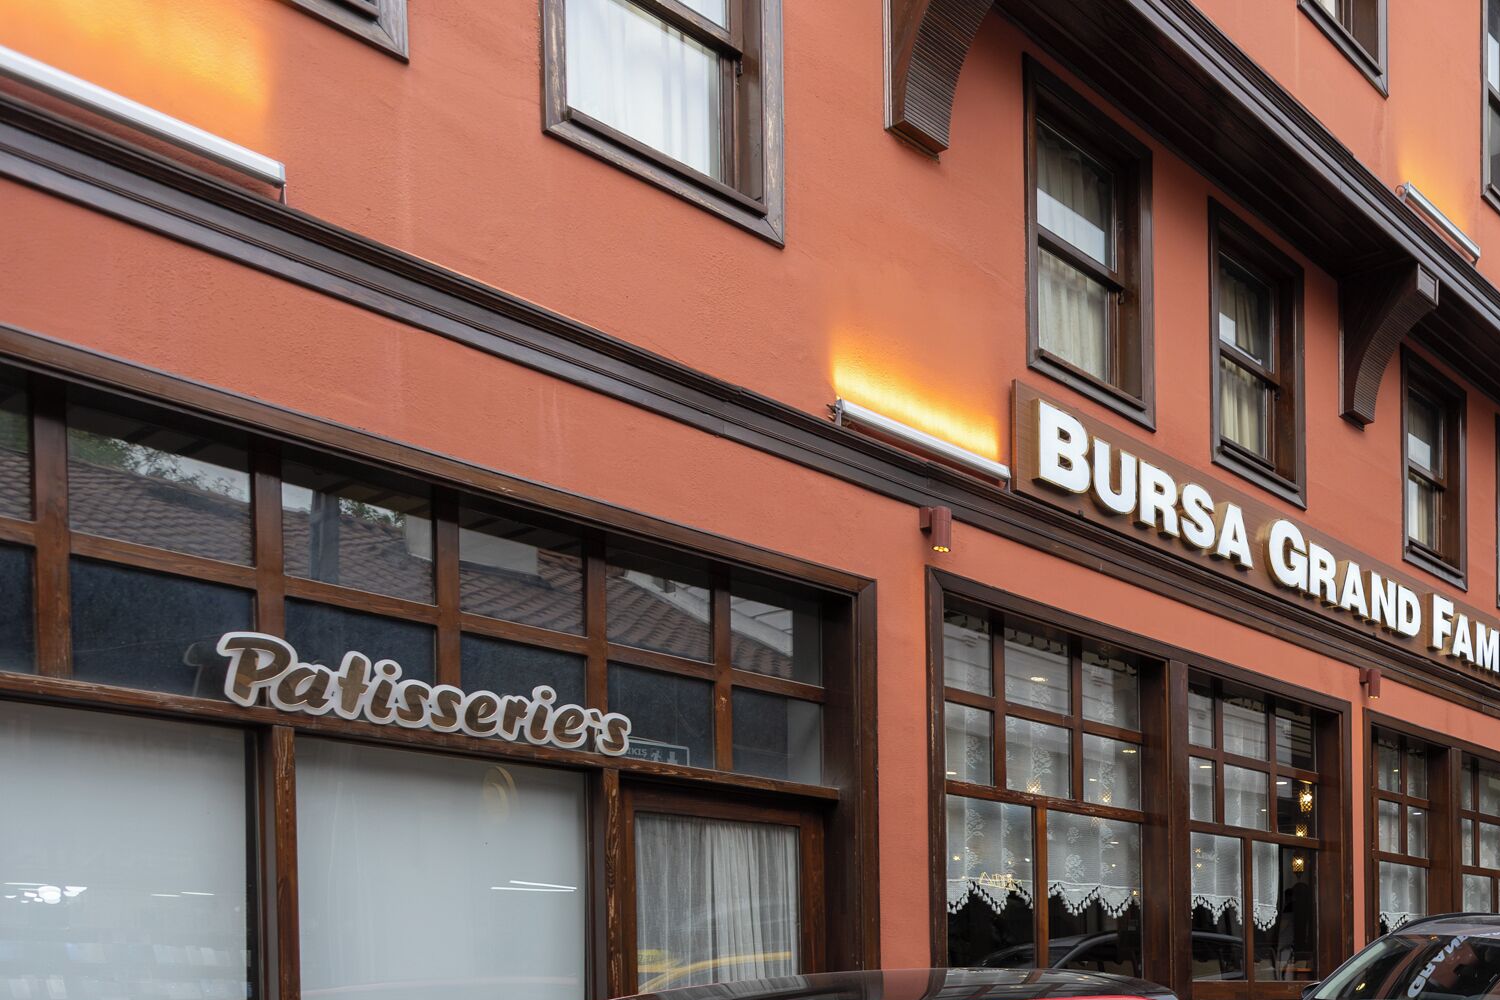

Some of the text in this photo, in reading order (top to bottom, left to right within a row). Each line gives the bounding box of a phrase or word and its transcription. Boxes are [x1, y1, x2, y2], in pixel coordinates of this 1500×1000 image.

[1036, 398, 1255, 570] BURSA
[1267, 518, 1423, 638] GRAND
[216, 631, 631, 757] Patisserie's
